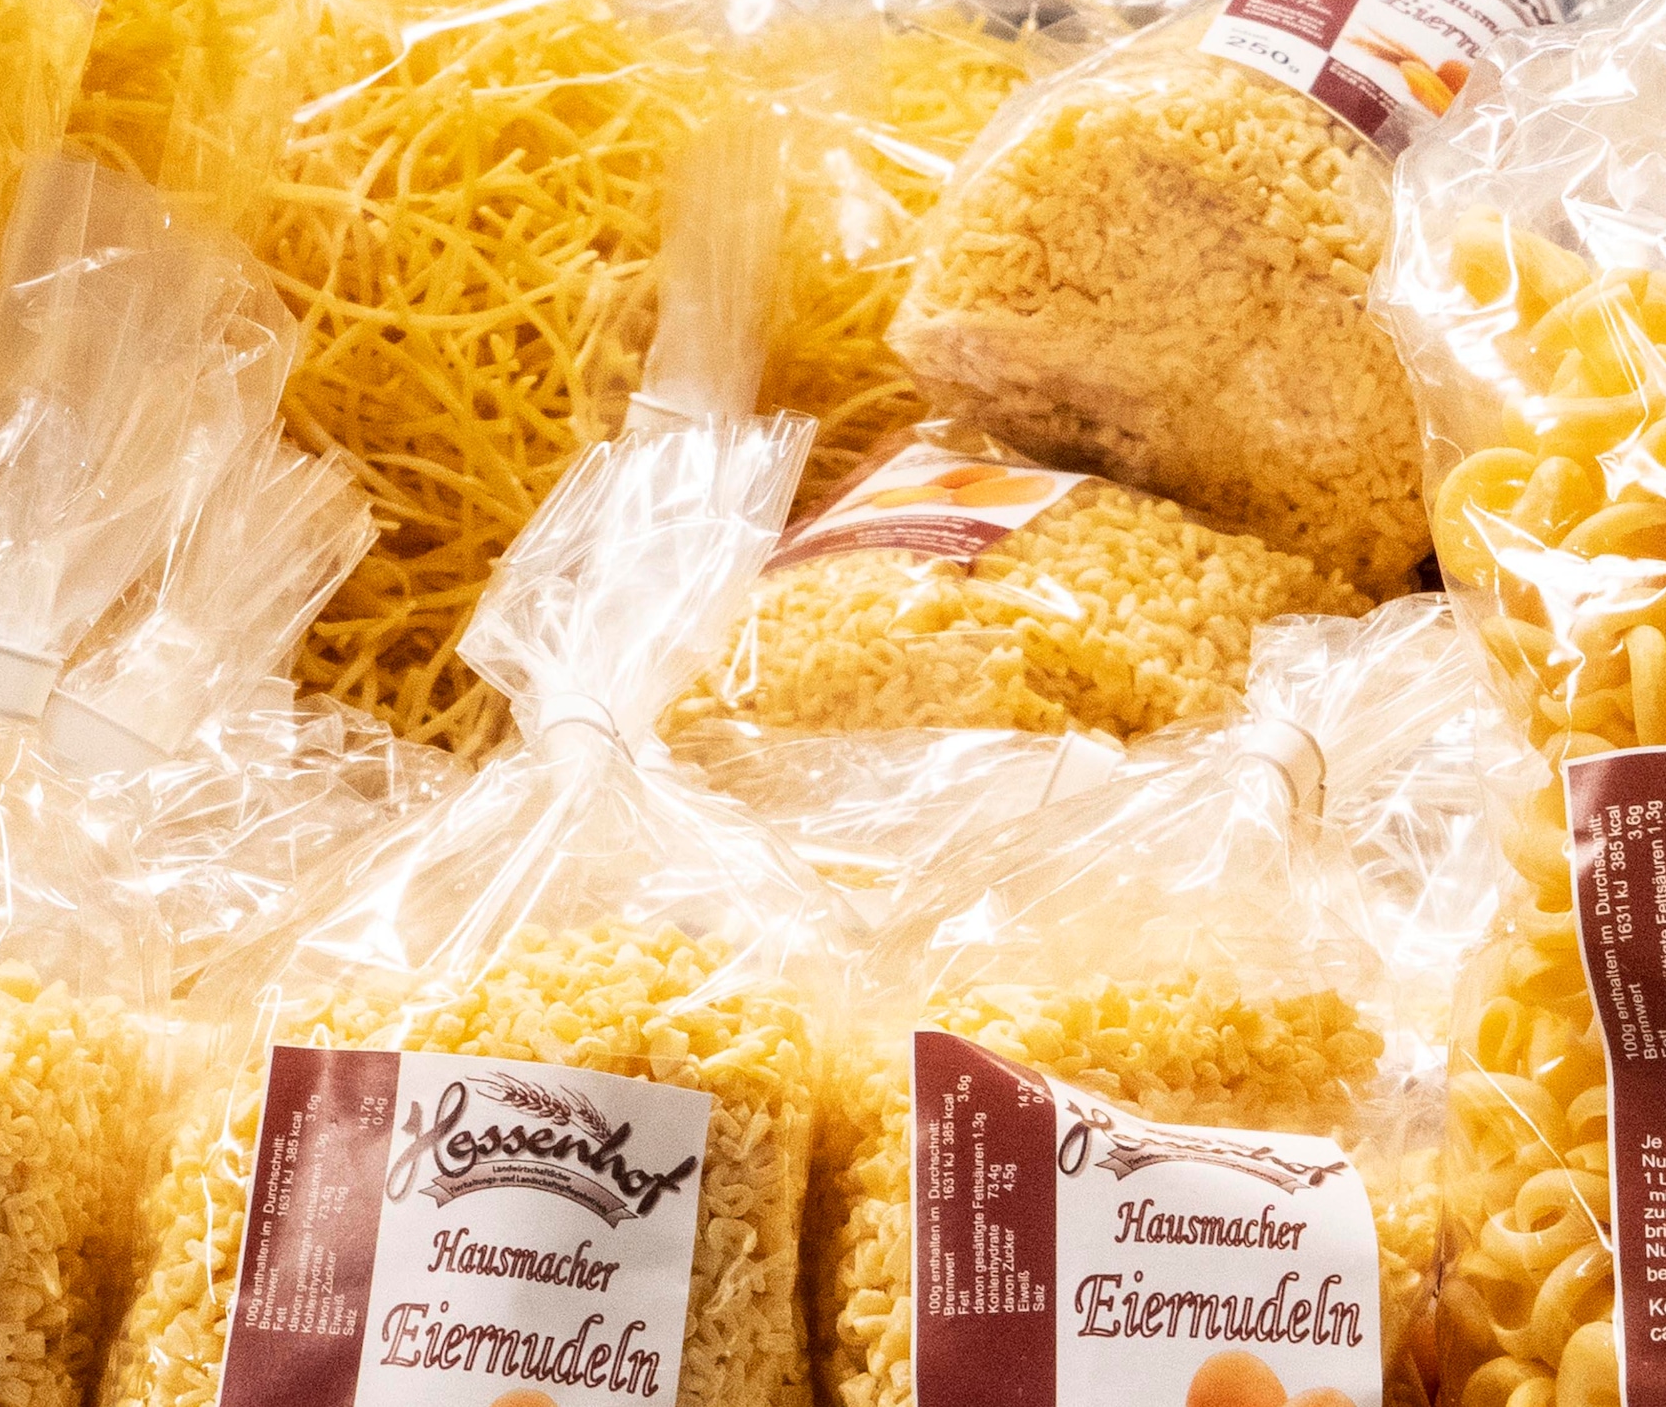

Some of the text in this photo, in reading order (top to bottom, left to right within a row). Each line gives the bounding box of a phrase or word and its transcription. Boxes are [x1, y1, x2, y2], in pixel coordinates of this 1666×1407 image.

[1600, 925, 1614, 944] im
[1605, 805, 1658, 1059] Brennwert 1631 kJ 385 kcal
[1605, 950, 1629, 1020] enthalten
[1621, 1024, 1640, 1061] 100g
[386, 1081, 698, 1217] Hessenhof
[1641, 1134, 1662, 1148] Je
[1644, 1172, 1651, 1184] 1
[1114, 1199, 1306, 1250] Hausmacher
[427, 1227, 620, 1293] Hausmacher
[1075, 1271, 1362, 1347] Eiernudeln
[380, 1301, 660, 1398] Eiernudeln
